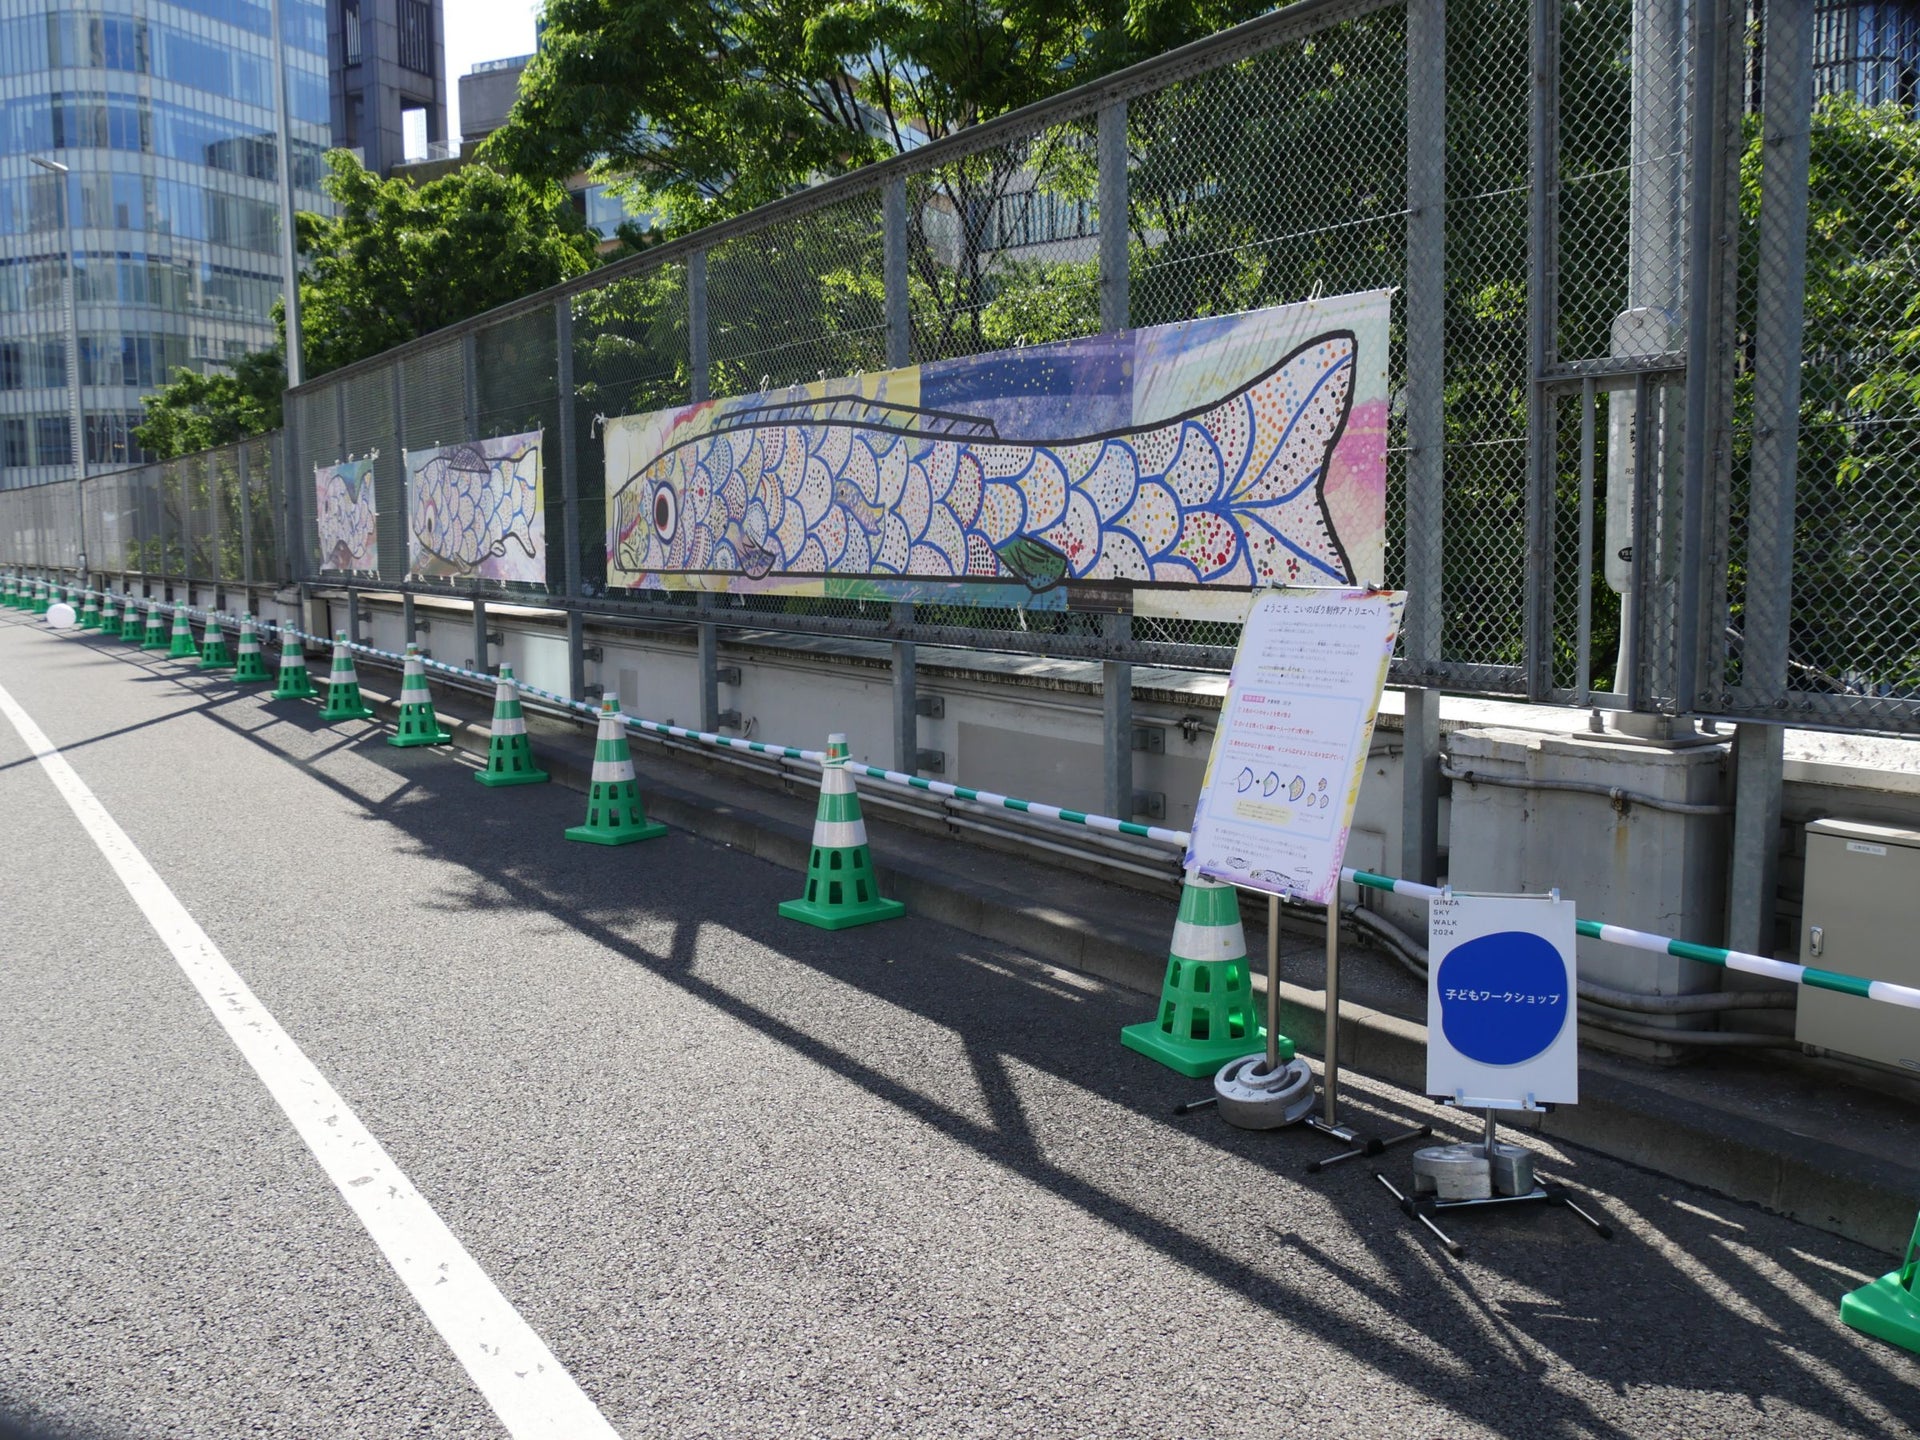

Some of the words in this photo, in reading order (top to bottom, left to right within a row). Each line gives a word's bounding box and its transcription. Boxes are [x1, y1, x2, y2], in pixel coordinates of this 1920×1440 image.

[1445, 988, 1560, 1005] 子どもワークショップ
